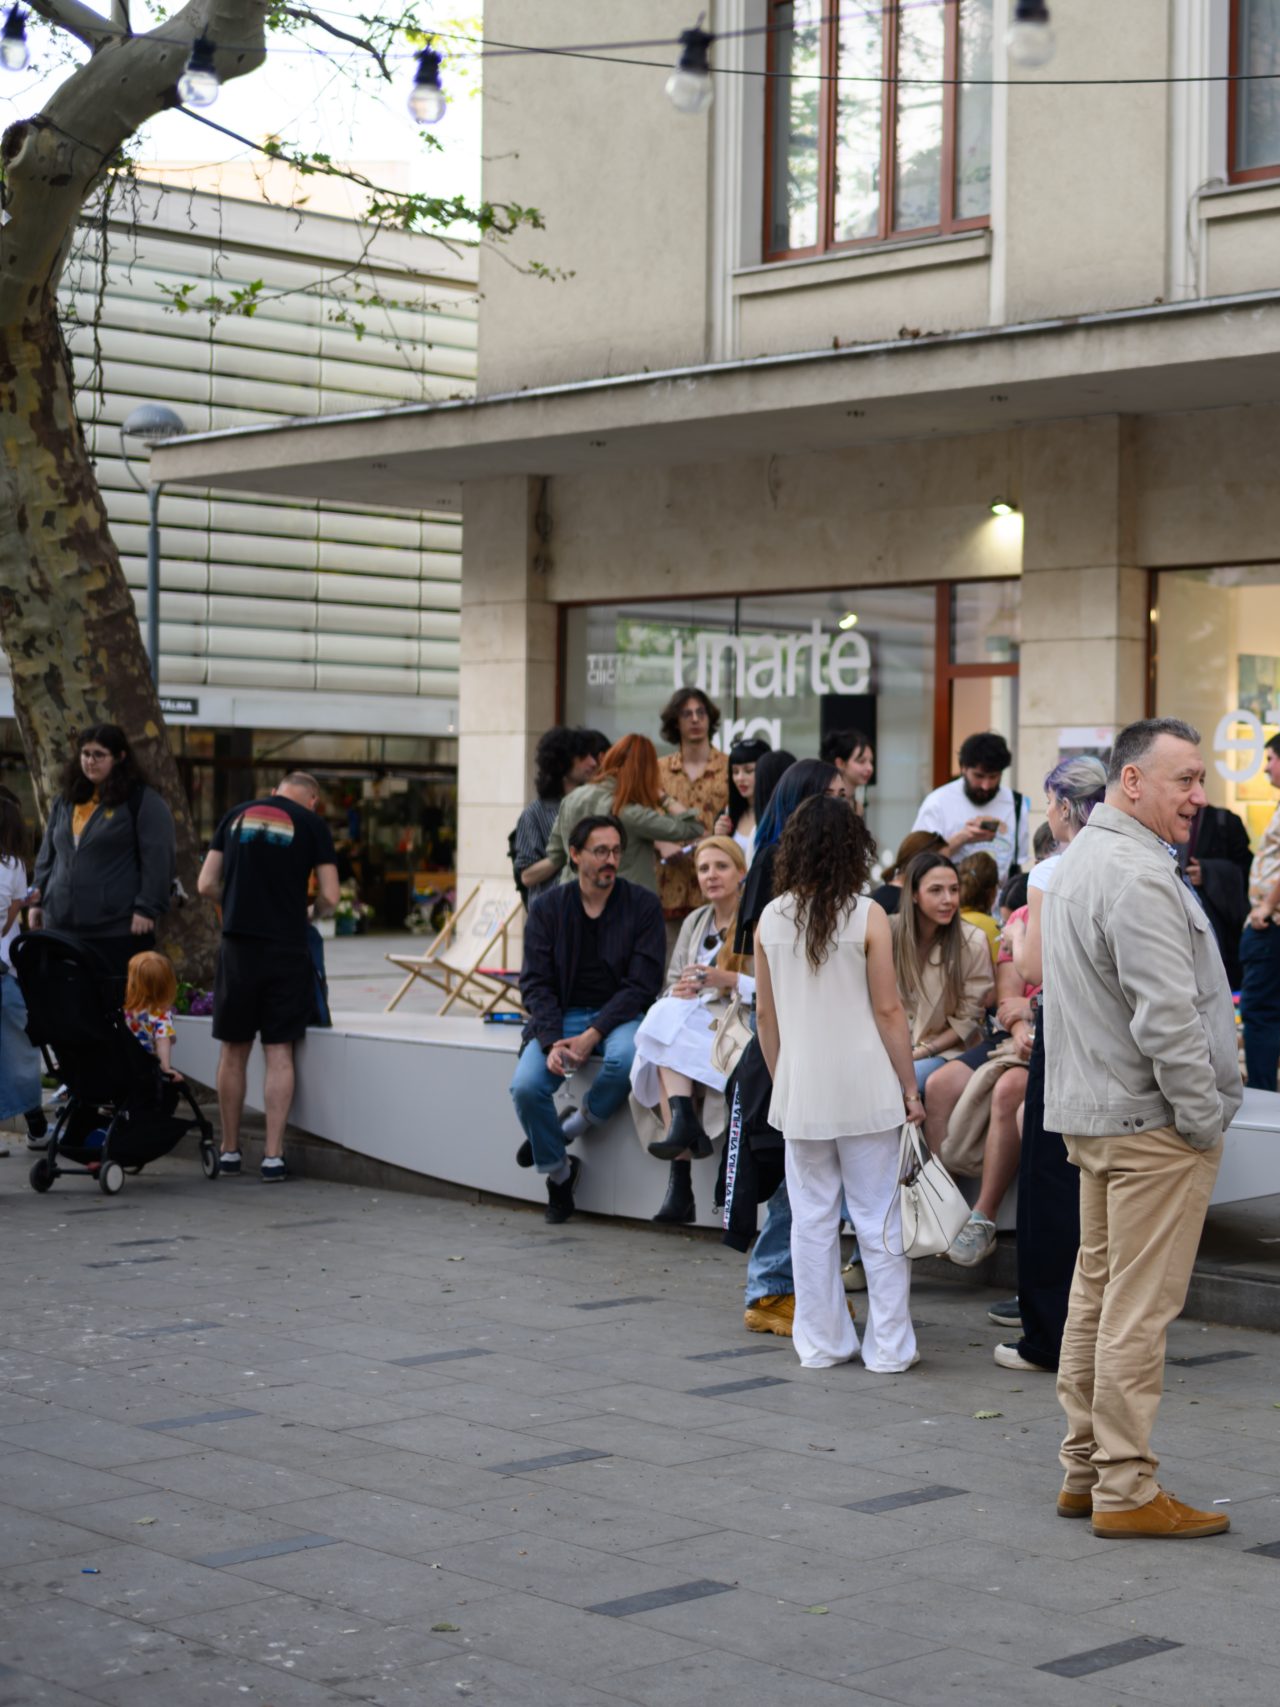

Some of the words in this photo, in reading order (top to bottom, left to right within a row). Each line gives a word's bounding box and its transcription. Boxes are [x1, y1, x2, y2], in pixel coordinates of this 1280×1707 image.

[673, 619, 871, 698] unarte
[730, 1130, 739, 1151] FILA
[727, 1153, 736, 1174] FILA
